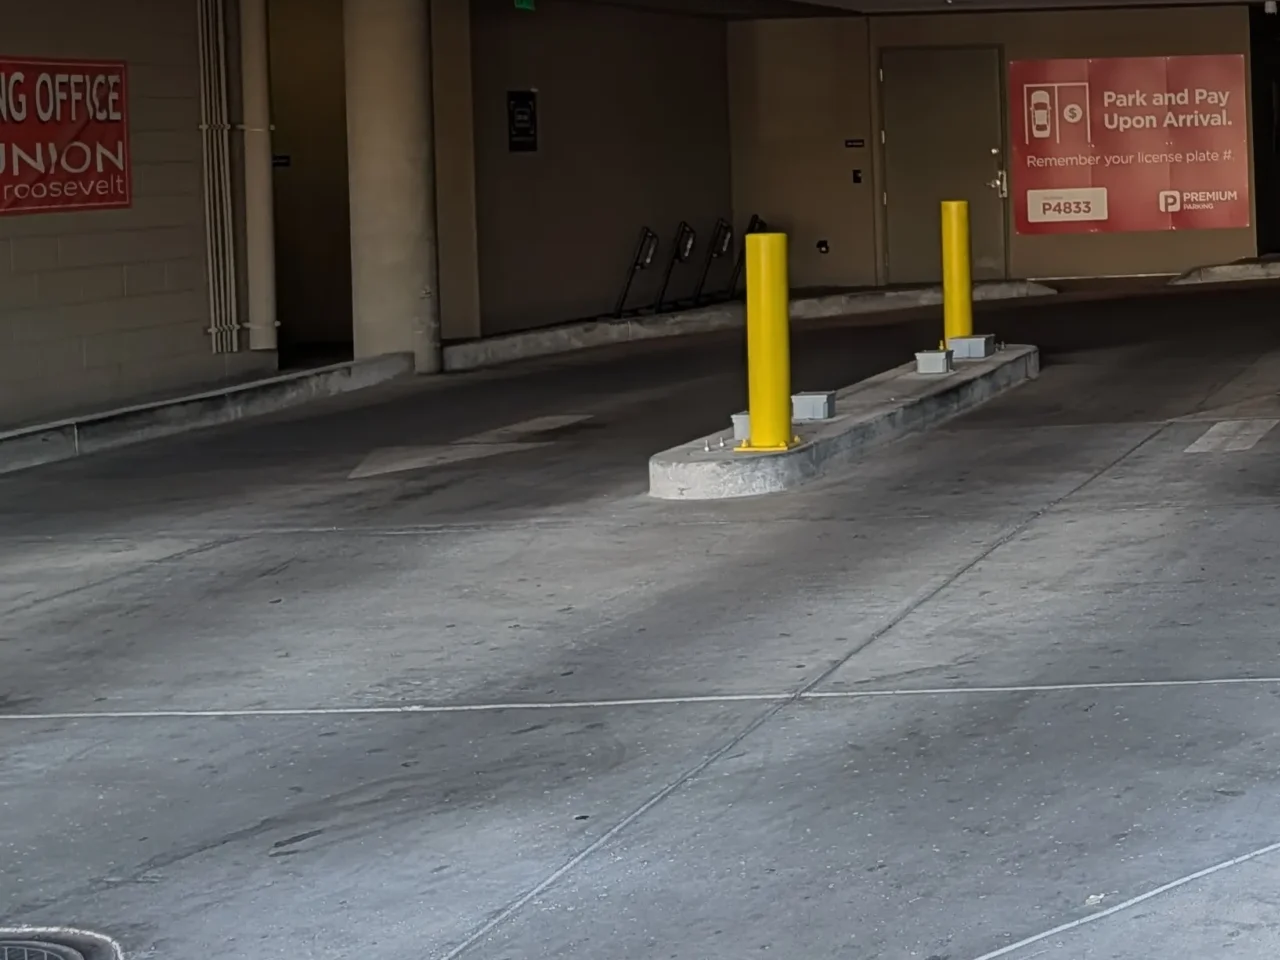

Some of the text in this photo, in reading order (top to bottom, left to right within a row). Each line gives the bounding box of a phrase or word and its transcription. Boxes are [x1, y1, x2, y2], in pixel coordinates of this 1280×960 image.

[35, 72, 122, 122] OFFICE
[1103, 88, 1230, 107] Park and Pay
[1104, 111, 1232, 132] Upon Arrival.
[0, 140, 124, 176] NION
[1027, 153, 1100, 168] Remember
[1103, 154, 1133, 167] your
[1137, 152, 1182, 164] license
[1186, 150, 1219, 165] plate
[4, 174, 124, 200] roosevelt
[1183, 191, 1237, 202] PREMIUM
[1041, 201, 1092, 215] P4833
